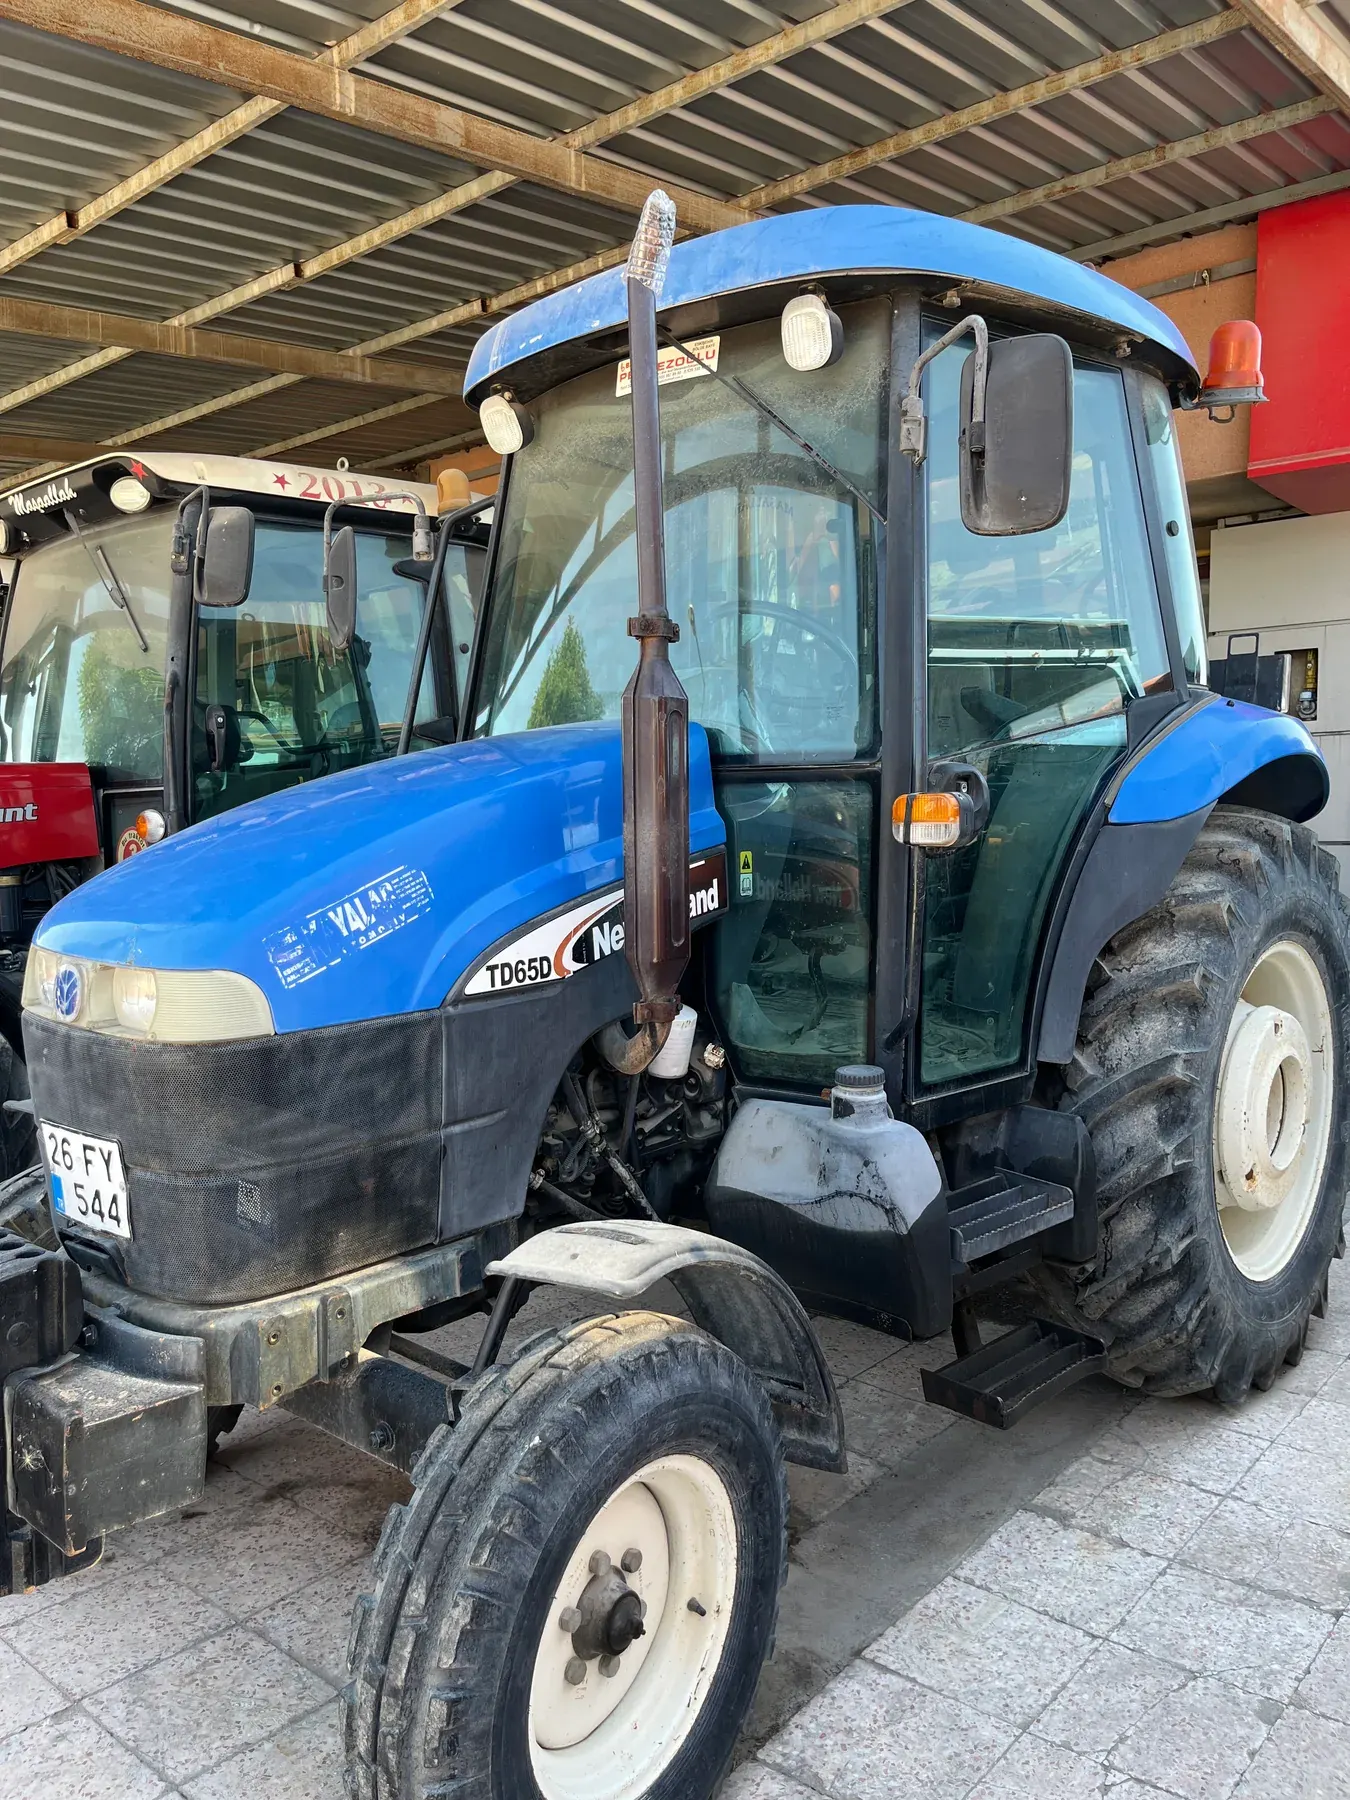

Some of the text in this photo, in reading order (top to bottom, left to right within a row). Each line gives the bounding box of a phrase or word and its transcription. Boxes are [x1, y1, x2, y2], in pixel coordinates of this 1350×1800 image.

[592, 920, 625, 961] Ne
[486, 955, 552, 988] TD65D
[48, 1132, 112, 1182] 26 FY
[74, 1182, 121, 1228] 544
